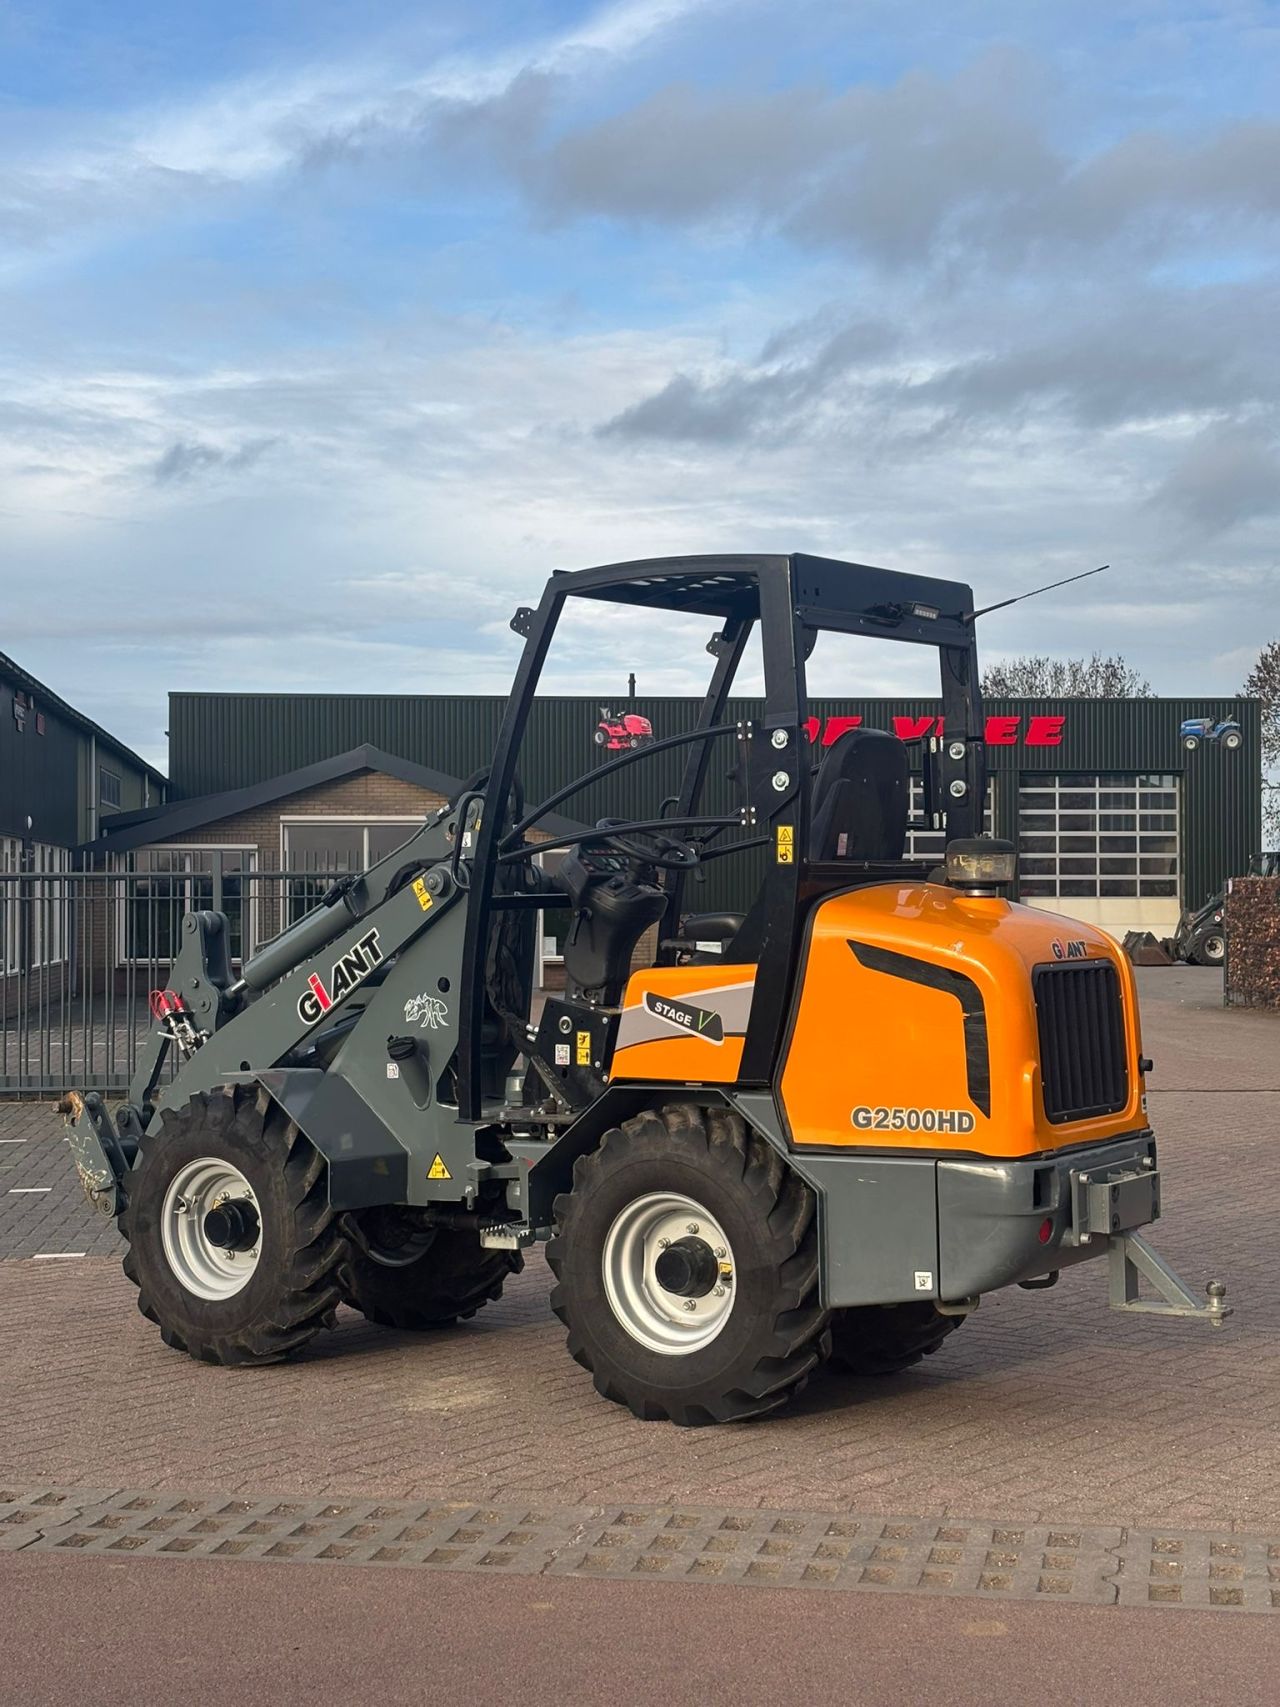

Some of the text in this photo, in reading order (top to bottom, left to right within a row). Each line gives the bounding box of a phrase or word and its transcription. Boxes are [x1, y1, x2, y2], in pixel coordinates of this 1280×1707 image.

[892, 715, 1066, 746] VEE
[654, 1001, 693, 1027] STAGE
[851, 1105, 976, 1135] G2500HD
